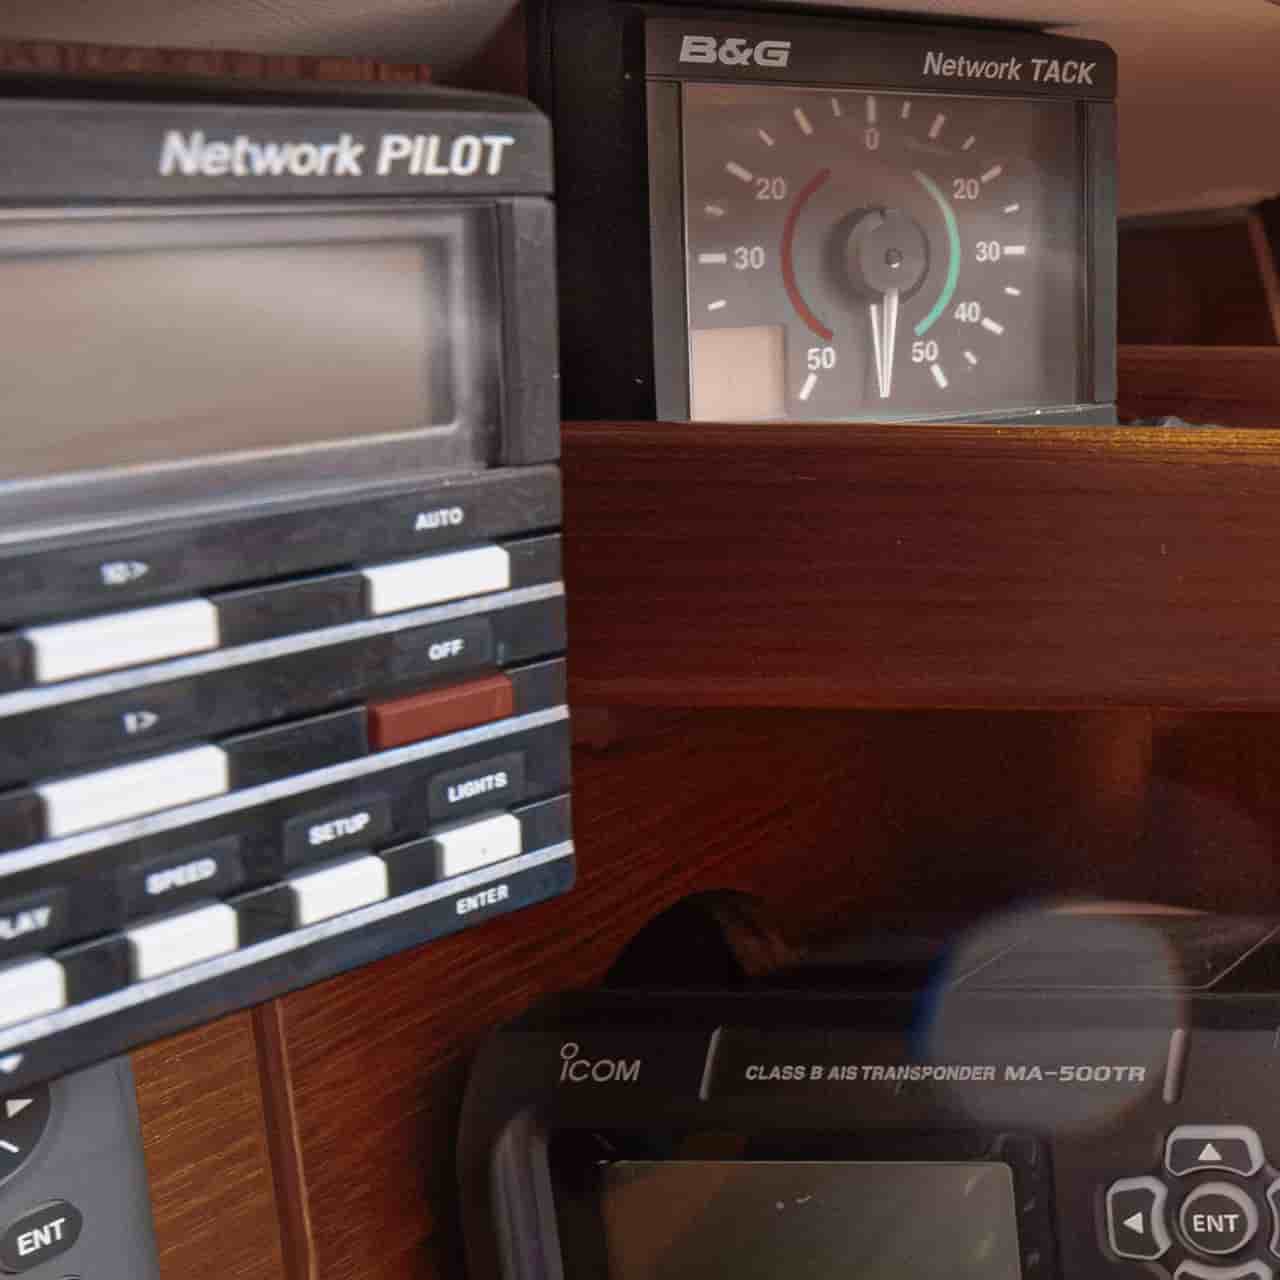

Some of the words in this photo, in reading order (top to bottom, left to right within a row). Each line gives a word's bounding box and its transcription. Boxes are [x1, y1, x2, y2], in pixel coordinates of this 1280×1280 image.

[680, 36, 791, 67] B&G
[923, 51, 1022, 81] Network
[1031, 59, 1095, 85] TACK
[866, 129, 879, 150] 0
[158, 131, 364, 177] Network
[377, 135, 515, 176] PILOT
[755, 178, 786, 200] 20
[953, 180, 980, 199] 20
[734, 247, 765, 269] 30
[975, 241, 1000, 261] 30
[954, 302, 981, 324] 40
[807, 348, 836, 370] 50
[911, 342, 938, 363] 50
[415, 507, 464, 530] AUTO
[429, 639, 465, 662] OFF
[447, 772, 508, 802] LIGHTS
[308, 813, 371, 844] SETUP
[146, 859, 218, 894] SPEED
[456, 885, 509, 914] ENTER
[745, 1064, 806, 1082] CLASS
[810, 1064, 823, 1082] B
[827, 1064, 859, 1082] AIS
[862, 1064, 996, 1082] TRANSPONDER
[1004, 1064, 1146, 1082] MA-500TR
[1192, 1214, 1240, 1233] ENT
[17, 1218, 65, 1256] ENT
